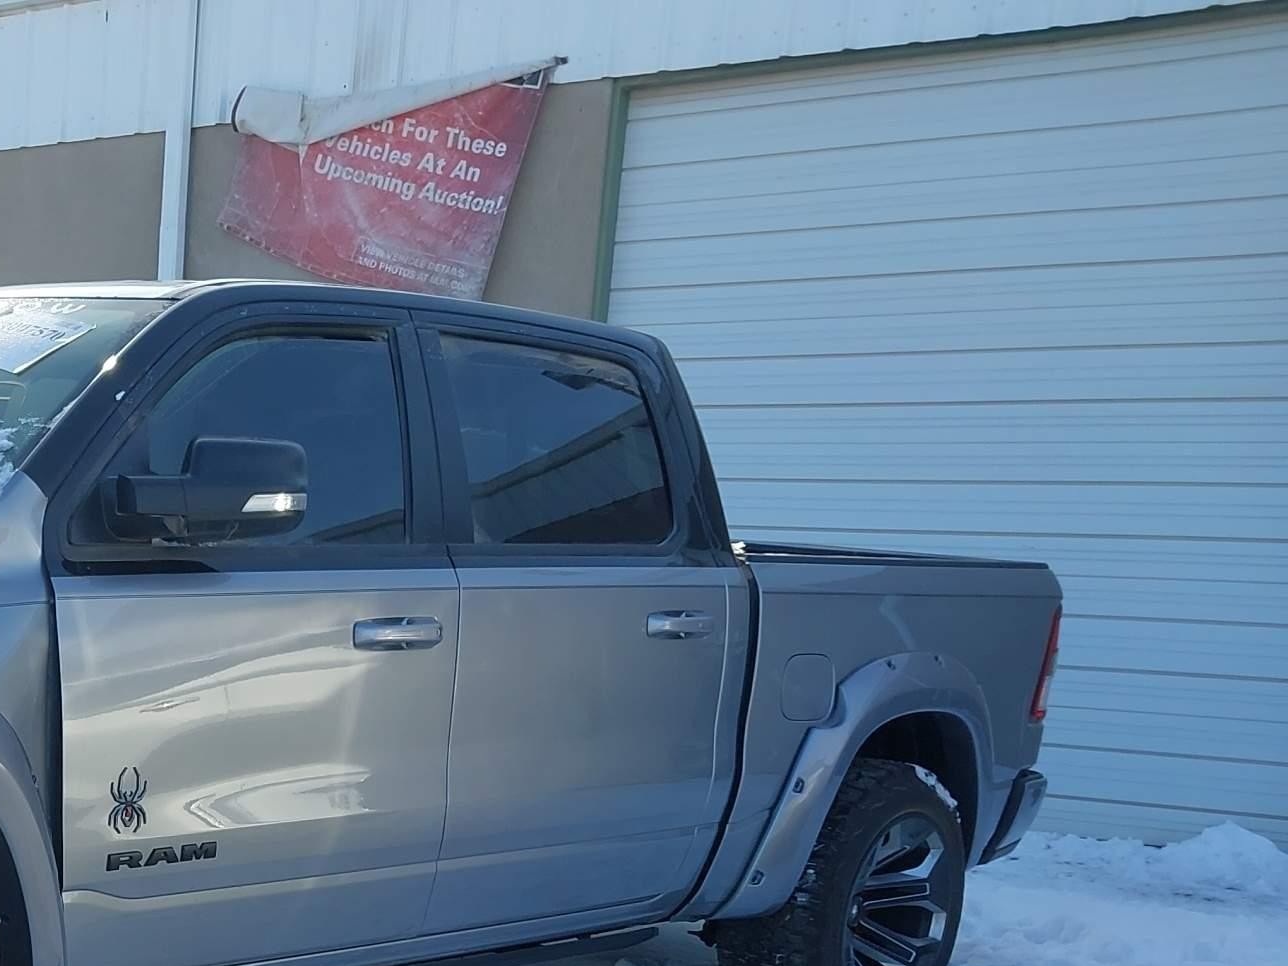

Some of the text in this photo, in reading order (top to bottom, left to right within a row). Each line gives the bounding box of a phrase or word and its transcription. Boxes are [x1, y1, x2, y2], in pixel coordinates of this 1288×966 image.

[402, 117, 439, 143] For
[446, 126, 507, 158] These
[417, 152, 446, 174] At
[450, 159, 481, 182] An
[314, 153, 505, 215] Upcoming Auction!
[378, 260, 417, 281] PHOTOS
[106, 841, 217, 871] RAM
